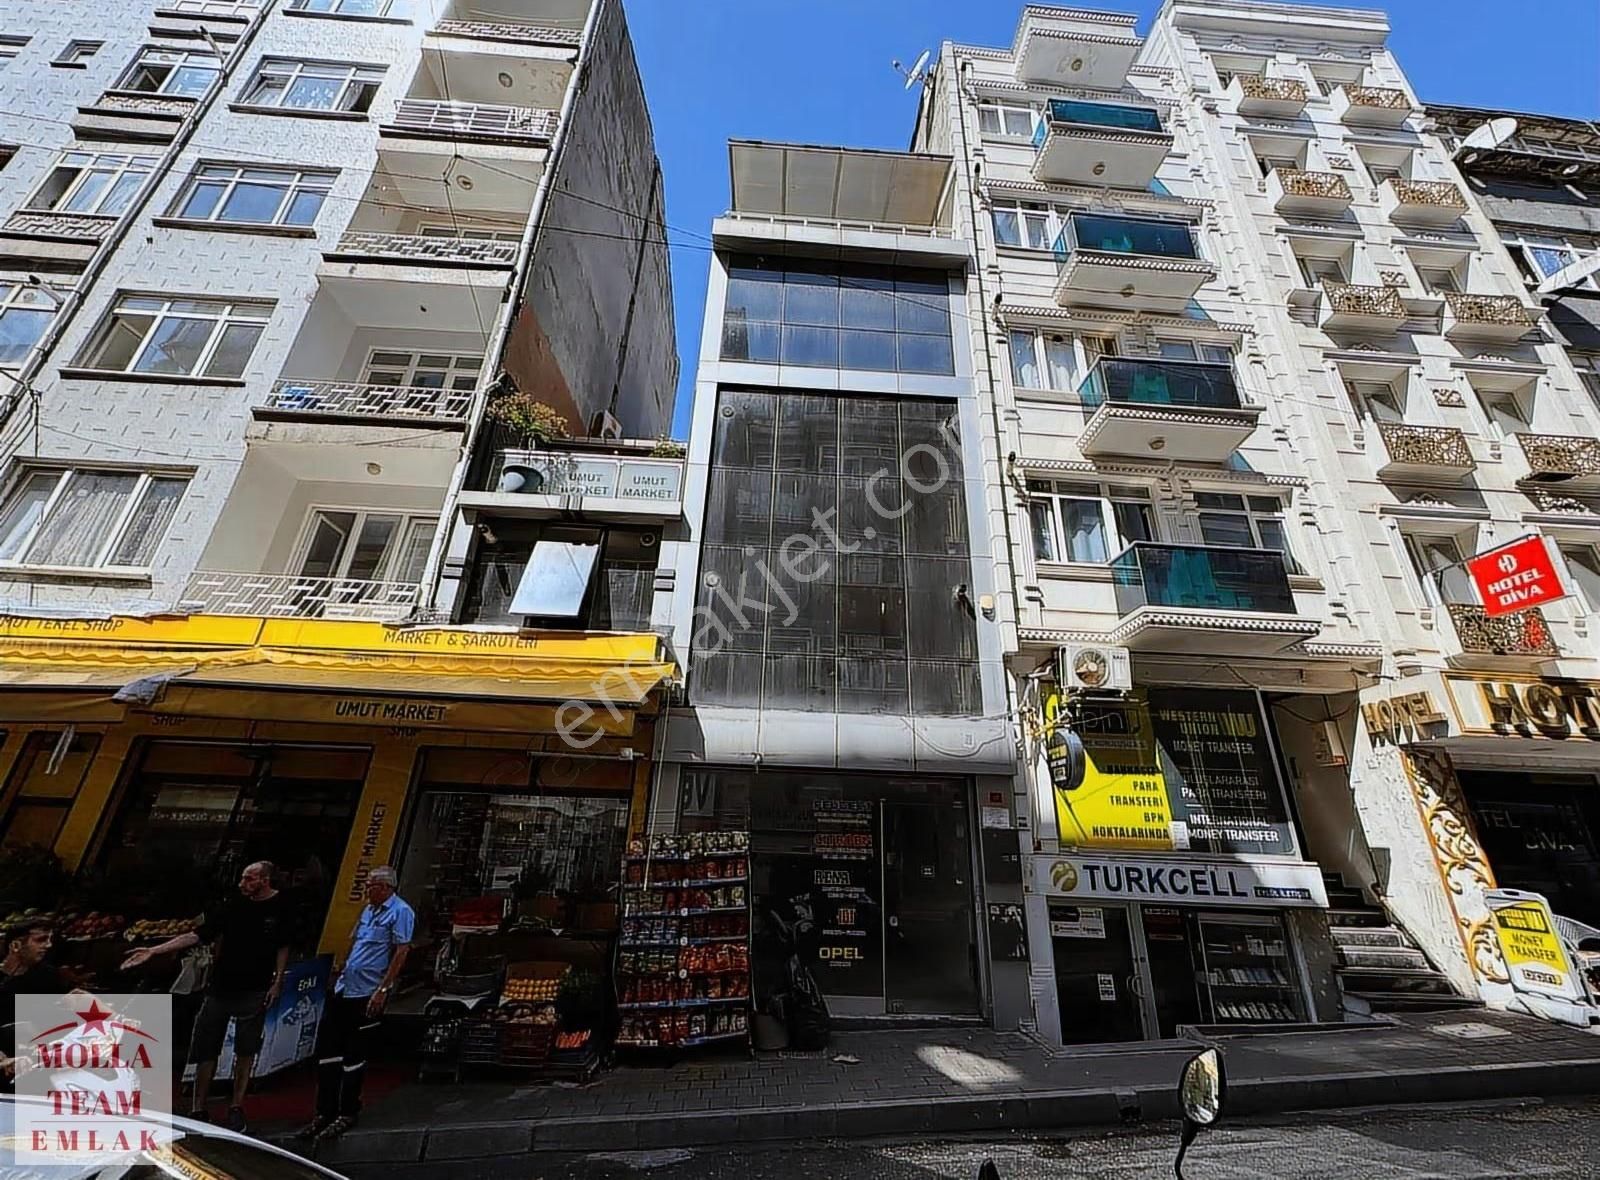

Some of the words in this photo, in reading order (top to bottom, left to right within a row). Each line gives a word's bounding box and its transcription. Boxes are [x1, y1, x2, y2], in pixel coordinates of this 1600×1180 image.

[569, 472, 602, 482] UMUT
[633, 475, 668, 486] UMUT
[622, 488, 673, 499] MARKET
[1487, 568, 1545, 595] HOTEL
[1498, 584, 1545, 606] DİVA
[383, 631, 441, 645] MARKET
[447, 634, 457, 646] &
[335, 701, 380, 717] UMUT
[382, 703, 447, 721] MARKET
[1159, 709, 1217, 722] WESTERN
[1476, 683, 1600, 735] HOT
[1180, 722, 1220, 735] UNION
[1206, 742, 1255, 754] TRANSFER
[1133, 780, 1158, 791] PARA
[1143, 811, 1165, 823] BPN
[1189, 814, 1270, 828] INTERNATIONAL
[1188, 828, 1223, 841] MONEY
[1225, 829, 1280, 843] TRANSFER
[348, 860, 371, 904] UMUT
[361, 801, 387, 856] MARKET
[1082, 864, 1249, 898] TURKCELL
[1511, 932, 1545, 947] MONEY
[819, 947, 864, 960] OPEL
[1509, 945, 1558, 961] TRANSFER
